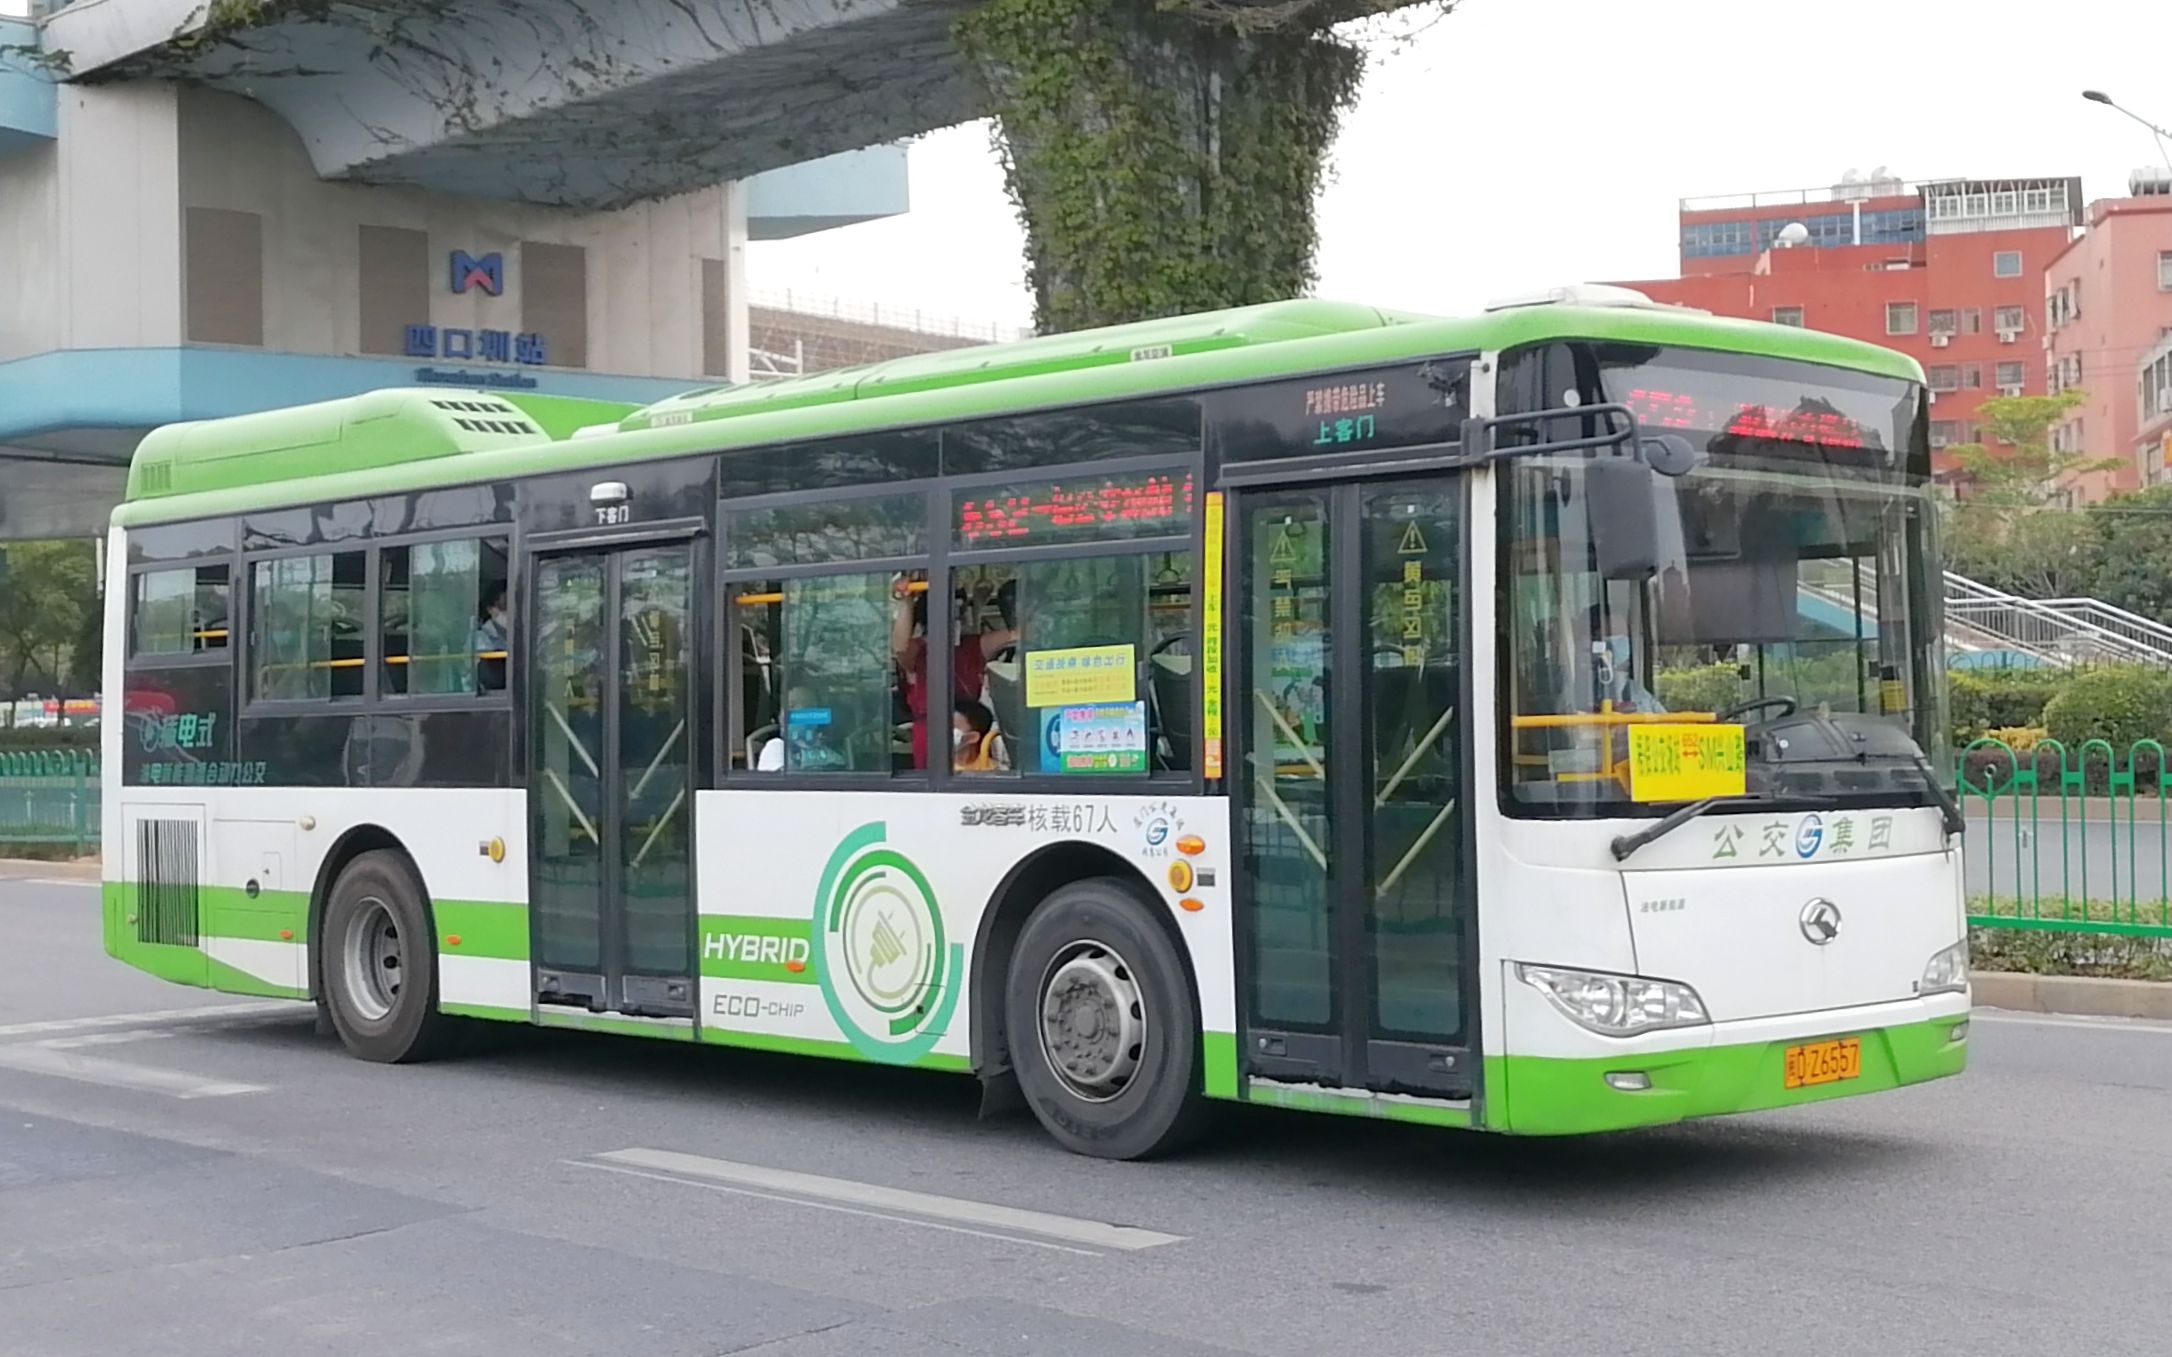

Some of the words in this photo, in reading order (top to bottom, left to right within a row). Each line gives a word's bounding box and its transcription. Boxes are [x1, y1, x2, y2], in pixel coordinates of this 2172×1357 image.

[1313, 414, 1375, 445] 上客门
[595, 505, 629, 525] 下客门
[1028, 803, 1118, 834] 核载67人
[1713, 820, 1789, 859] 公交
[1829, 816, 1893, 854] 集团
[704, 933, 810, 964] HYBRID
[713, 995, 804, 1017] ECO-CHIP
